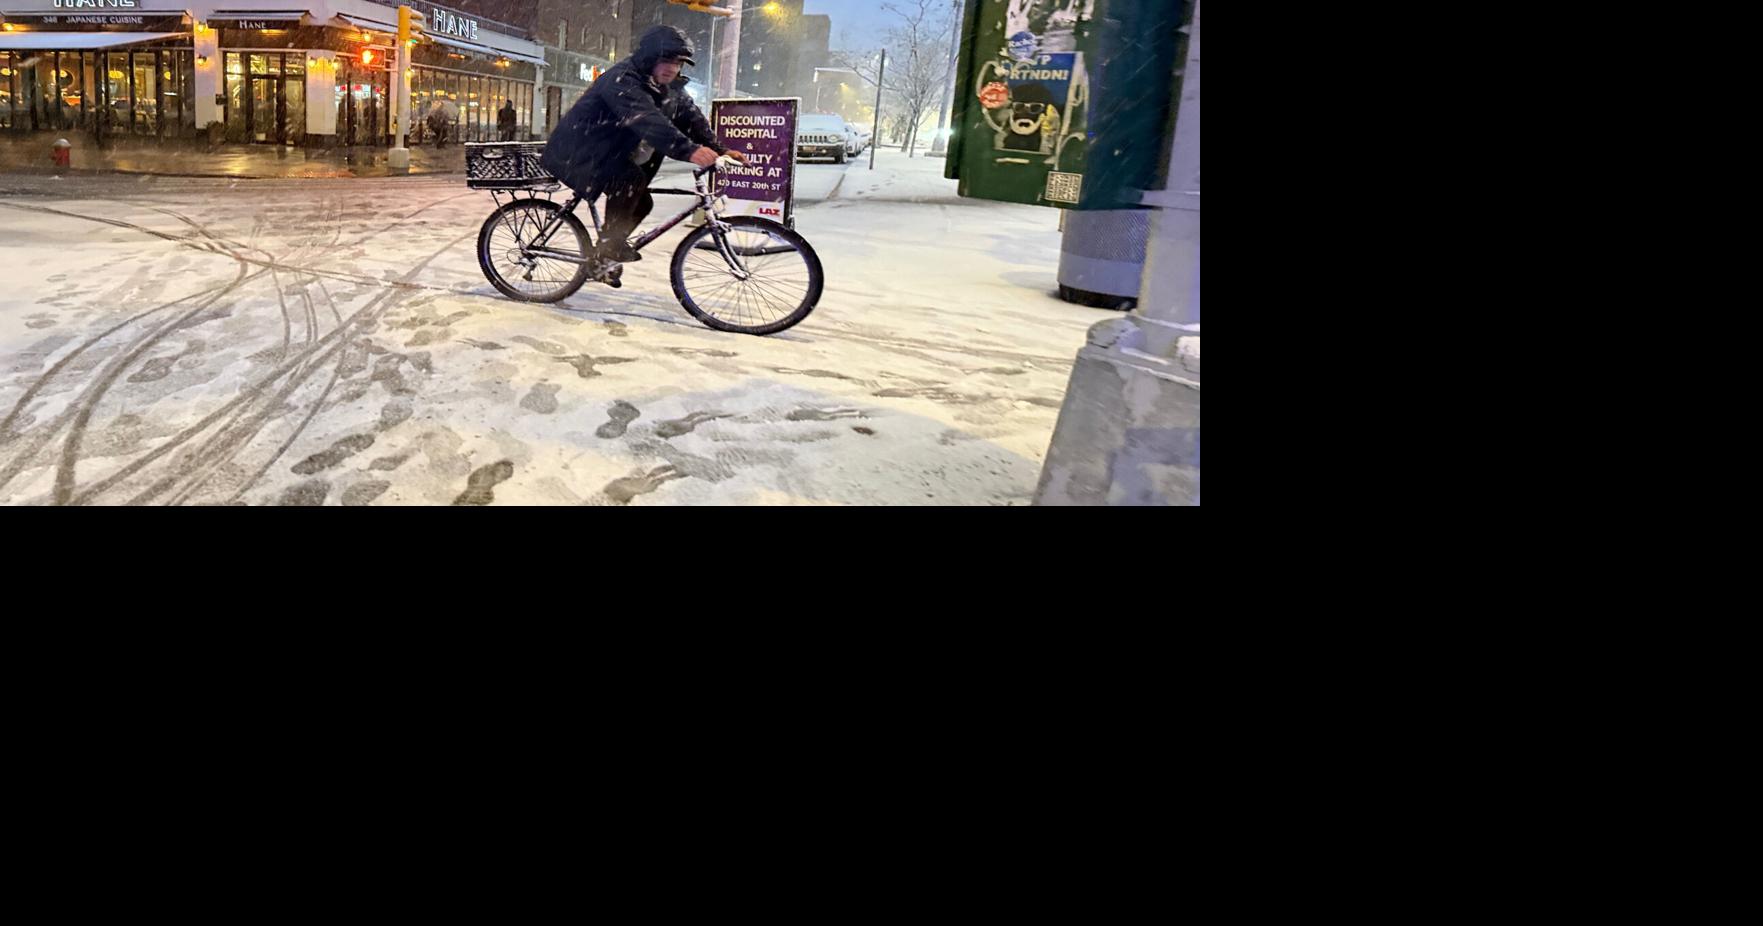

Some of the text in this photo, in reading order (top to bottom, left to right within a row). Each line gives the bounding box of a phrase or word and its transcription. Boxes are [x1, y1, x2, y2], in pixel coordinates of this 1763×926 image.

[66, 16, 107, 24] JAPANESE
[110, 16, 143, 24] CUISINE
[433, 8, 478, 40] HANE
[720, 115, 786, 126] DISCOUNTED
[725, 128, 777, 139] HOSPITAL
[746, 142, 753, 150] &
[743, 153, 773, 164] ULTY
[718, 165, 782, 178] RKING AT
[731, 180, 750, 189] EAST
[752, 182, 769, 191] 20th
[771, 183, 781, 191] ST
[758, 207, 780, 216] LAZ
